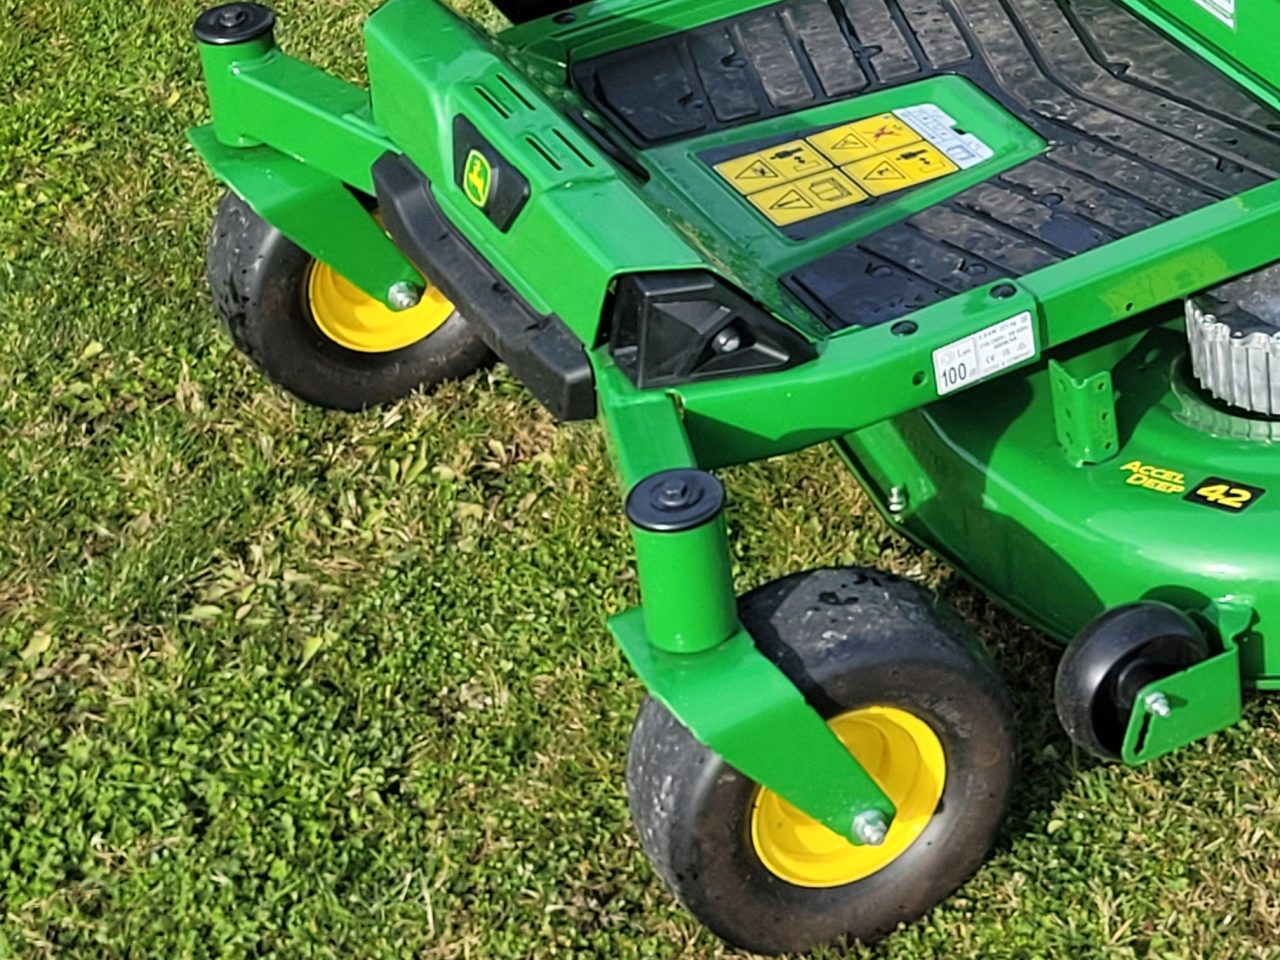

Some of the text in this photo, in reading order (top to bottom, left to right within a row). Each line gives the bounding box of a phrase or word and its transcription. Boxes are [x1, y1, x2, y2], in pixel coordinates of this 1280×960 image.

[941, 362, 967, 388] 100
[1120, 461, 1185, 485] ACCEL
[1126, 473, 1186, 495] DEEP
[1196, 484, 1252, 509] 42
